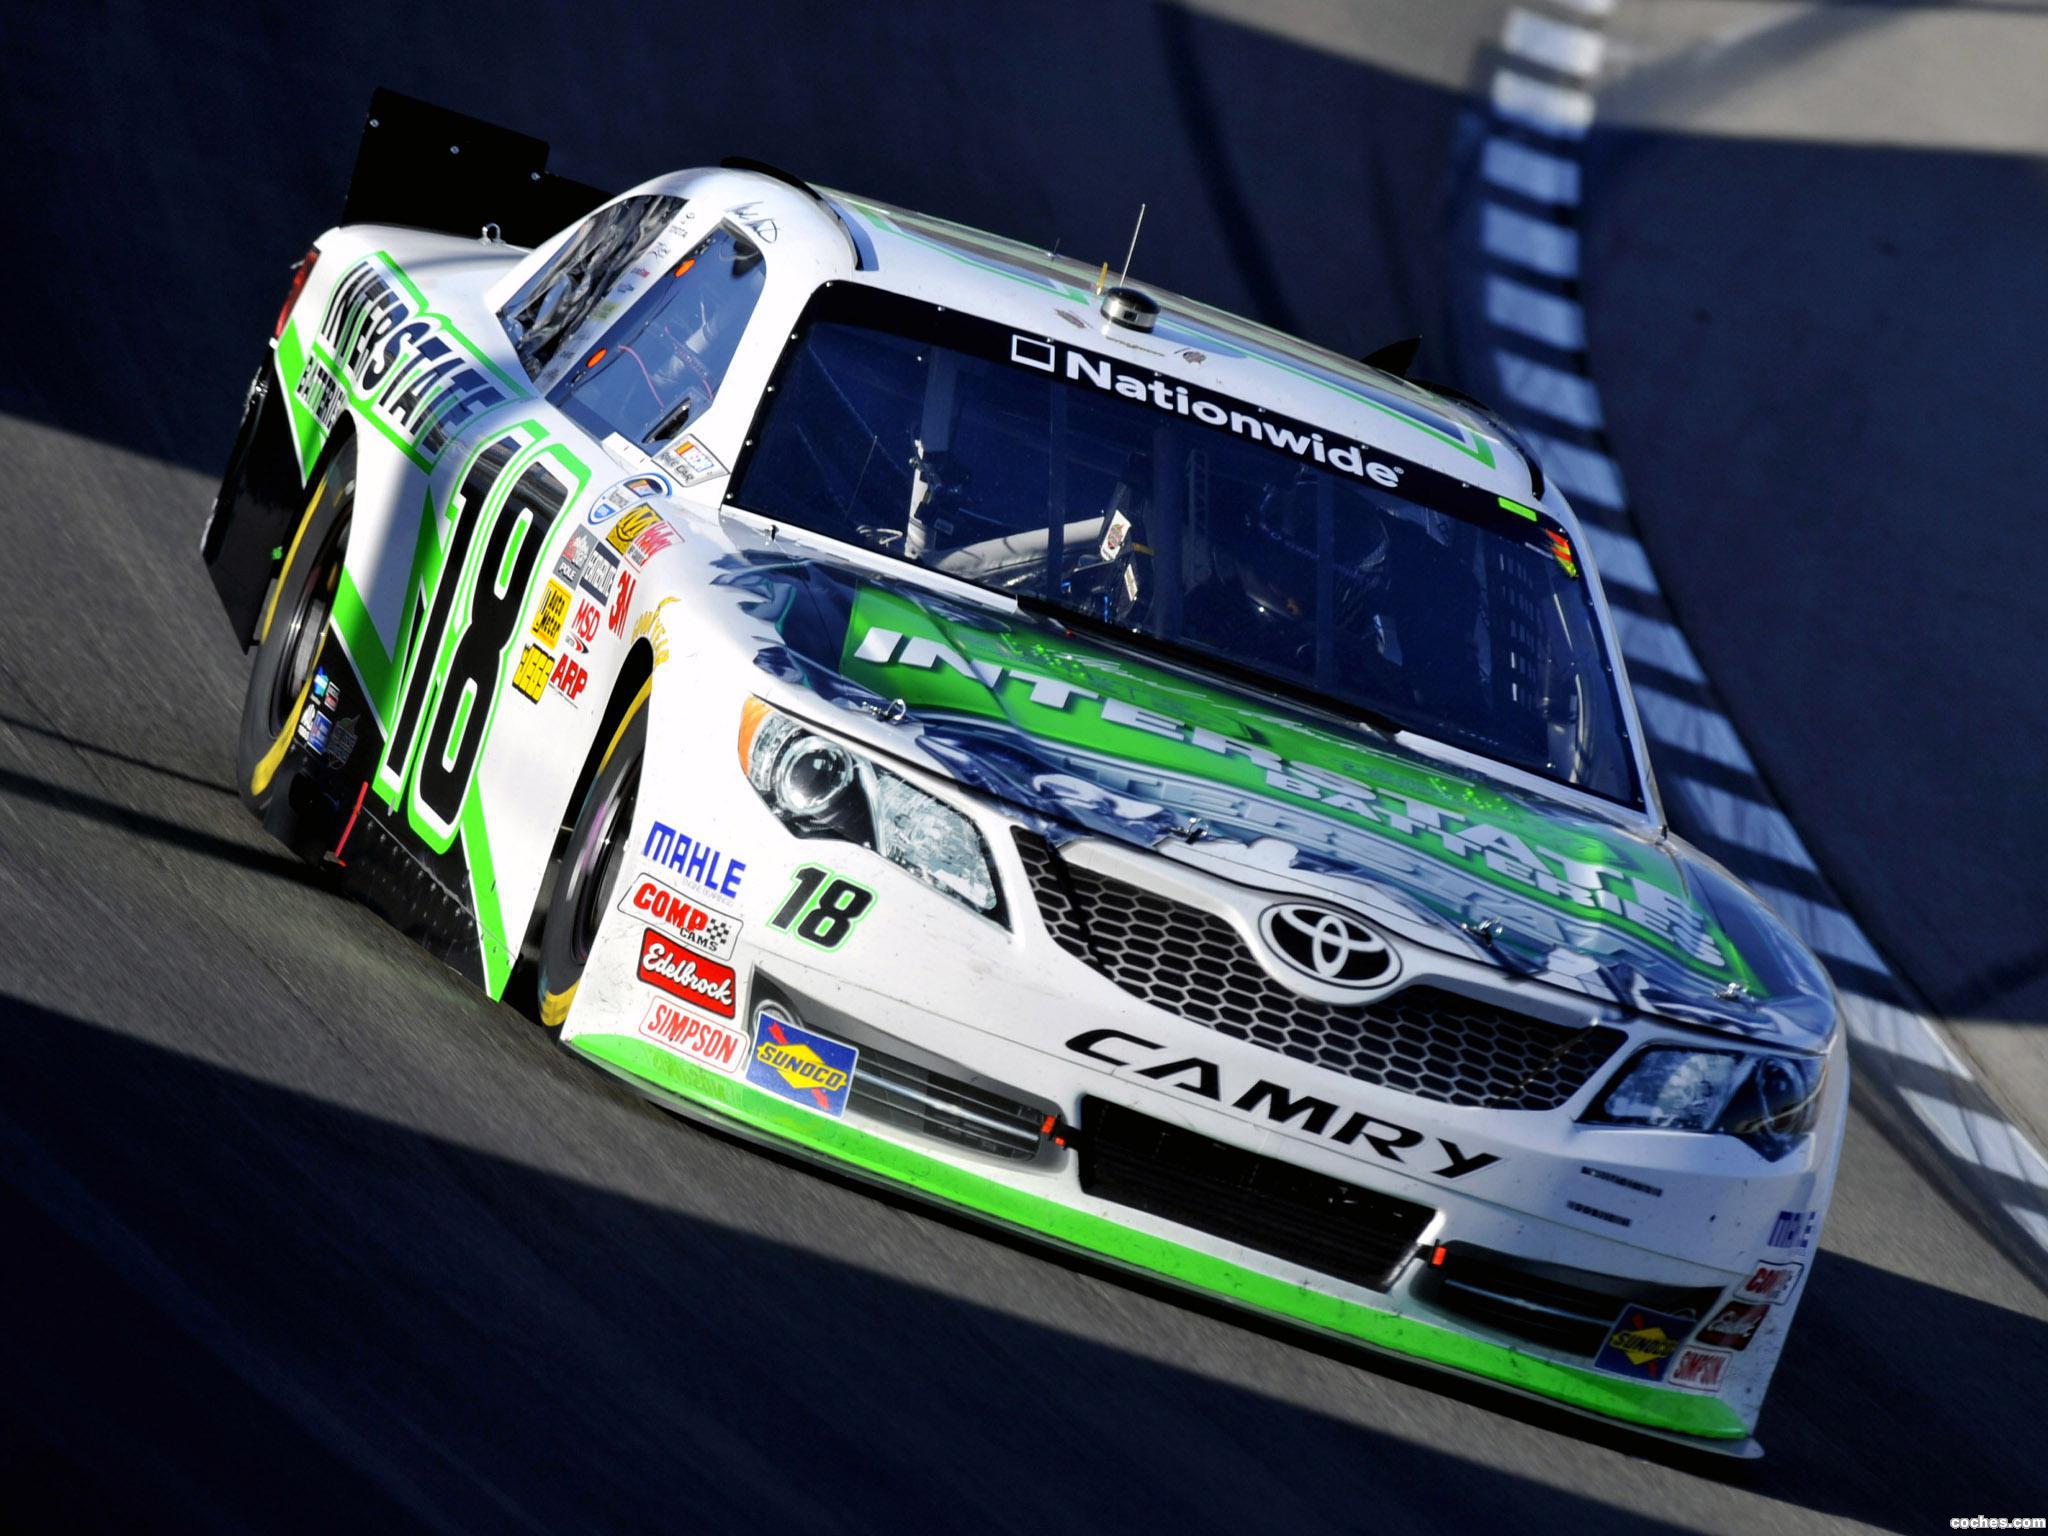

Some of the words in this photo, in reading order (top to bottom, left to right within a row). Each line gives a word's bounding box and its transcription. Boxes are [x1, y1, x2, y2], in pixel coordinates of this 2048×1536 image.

[321, 261, 507, 456] INTERSTATE
[558, 562, 576, 582] POLE
[609, 570, 636, 640] 3M
[386, 436, 569, 826] 18
[571, 598, 601, 642] MSD
[550, 653, 588, 701] ARP
[854, 626, 1714, 945] INTERSTATE
[642, 821, 747, 899] MAHLE
[1266, 770, 1726, 967] BATTERIES
[632, 882, 709, 933] COMP
[679, 926, 719, 952] CAMS
[771, 866, 874, 949] 18
[642, 943, 733, 1006] Edelbrock
[647, 1003, 739, 1064] SIMPSON
[758, 1044, 847, 1092] SUNOCO
[1065, 1028, 1502, 1179] CAMRY
